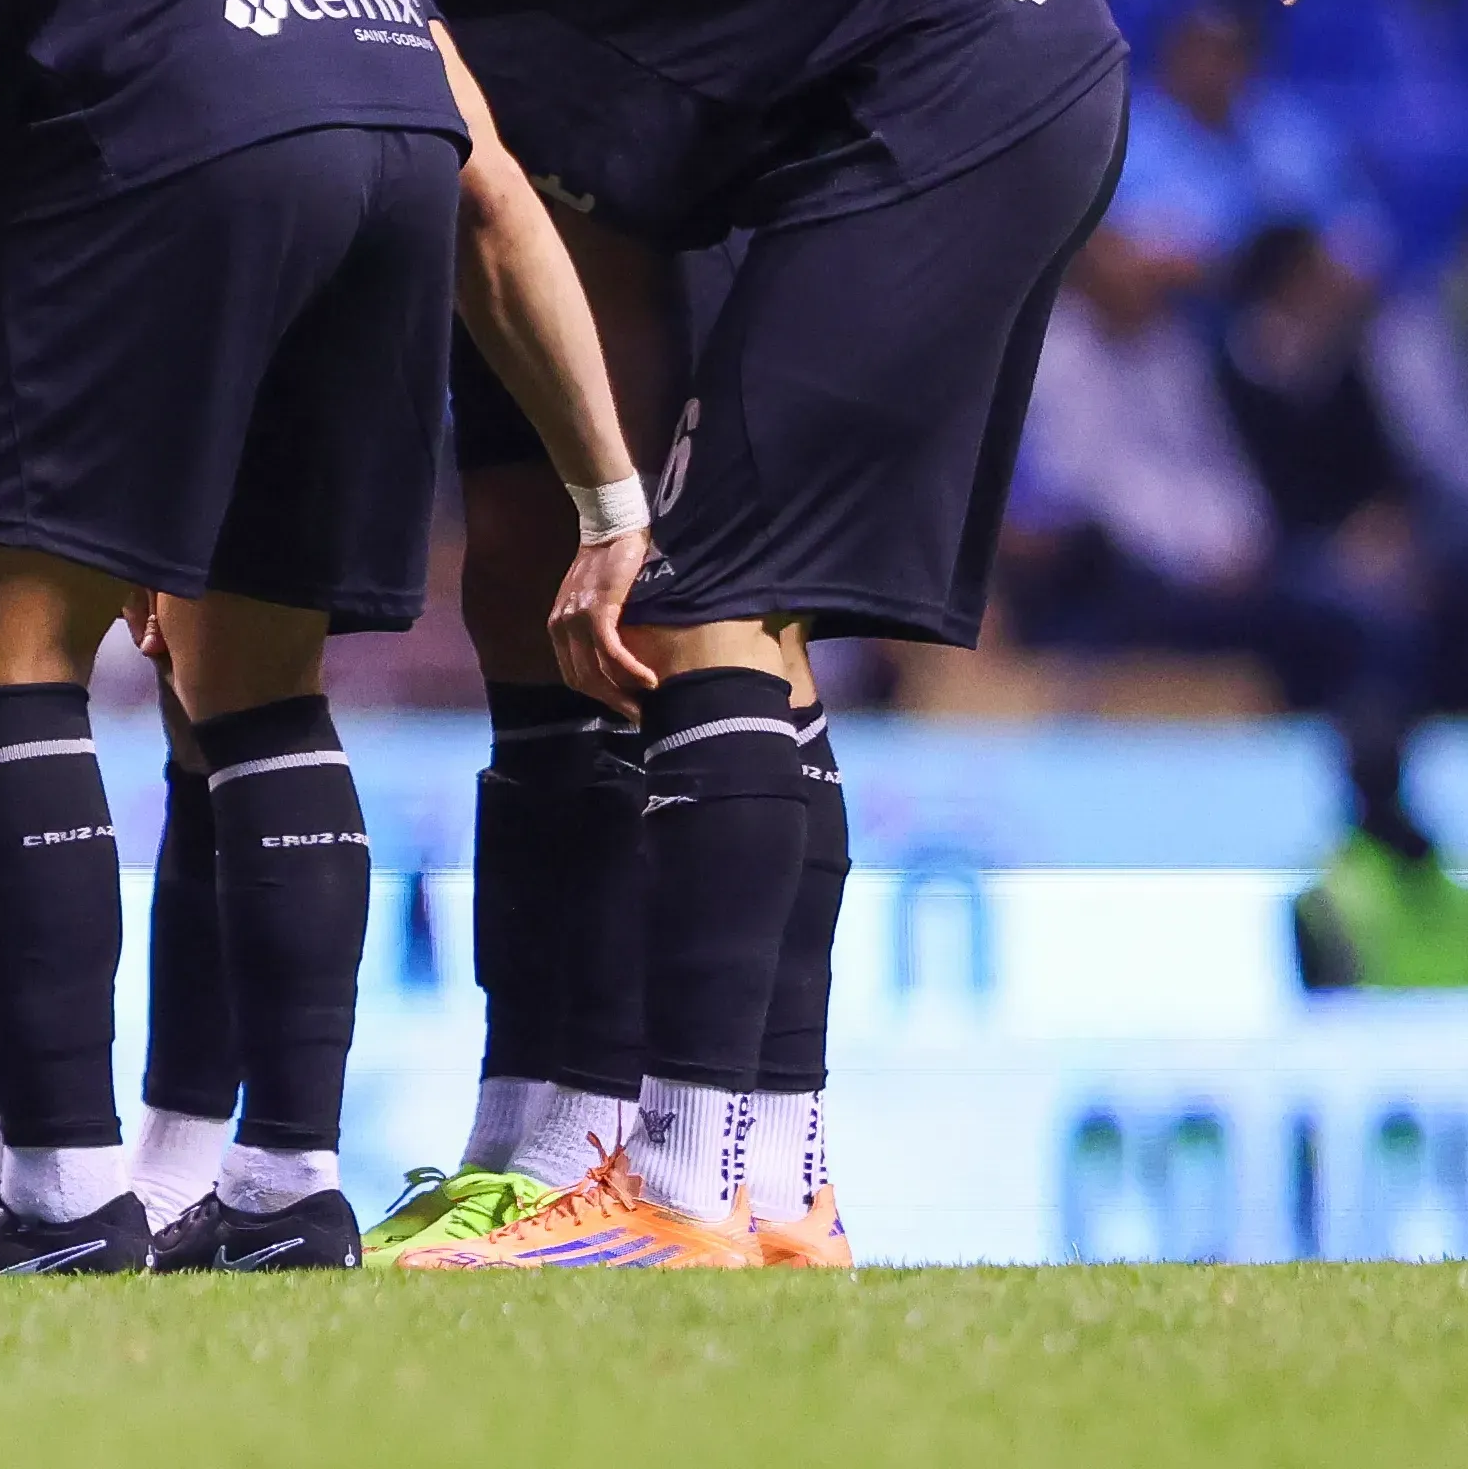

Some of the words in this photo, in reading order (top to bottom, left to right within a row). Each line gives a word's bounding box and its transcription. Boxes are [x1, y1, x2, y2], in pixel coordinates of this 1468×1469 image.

[23, 826, 93, 847] CRUZ
[94, 825, 115, 837] AZ
[261, 832, 334, 848] CRUZ
